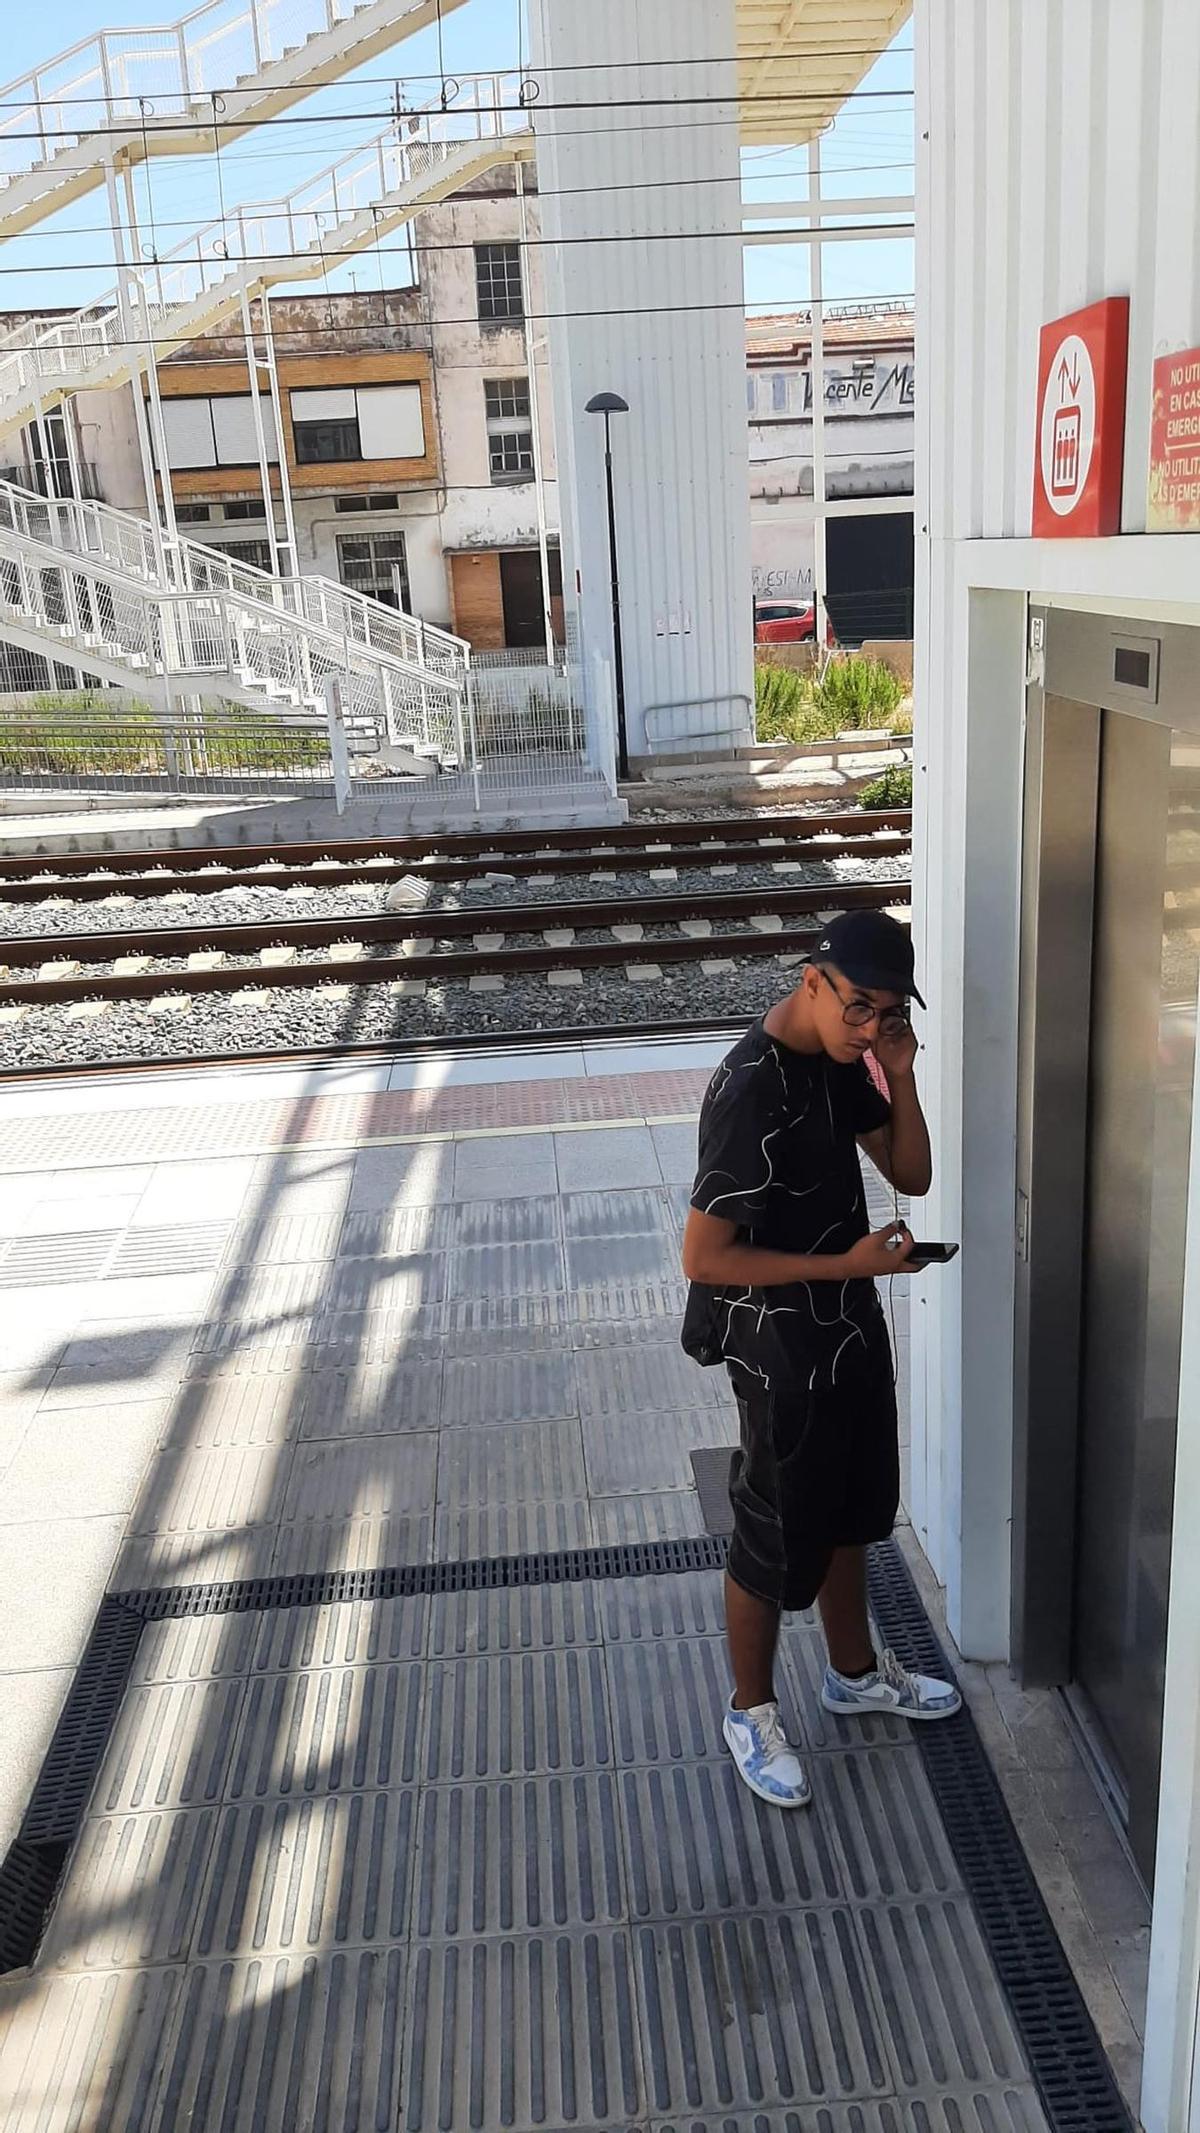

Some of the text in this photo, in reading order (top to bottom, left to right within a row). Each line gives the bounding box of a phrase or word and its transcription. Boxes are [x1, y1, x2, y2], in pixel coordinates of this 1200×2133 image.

[1170, 368, 1183, 387] NO
[801, 369, 874, 412] Vcente
[1170, 394, 1182, 412] EN
[1167, 416, 1200, 438] EMERG
[1172, 456, 1200, 477] UTILIT
